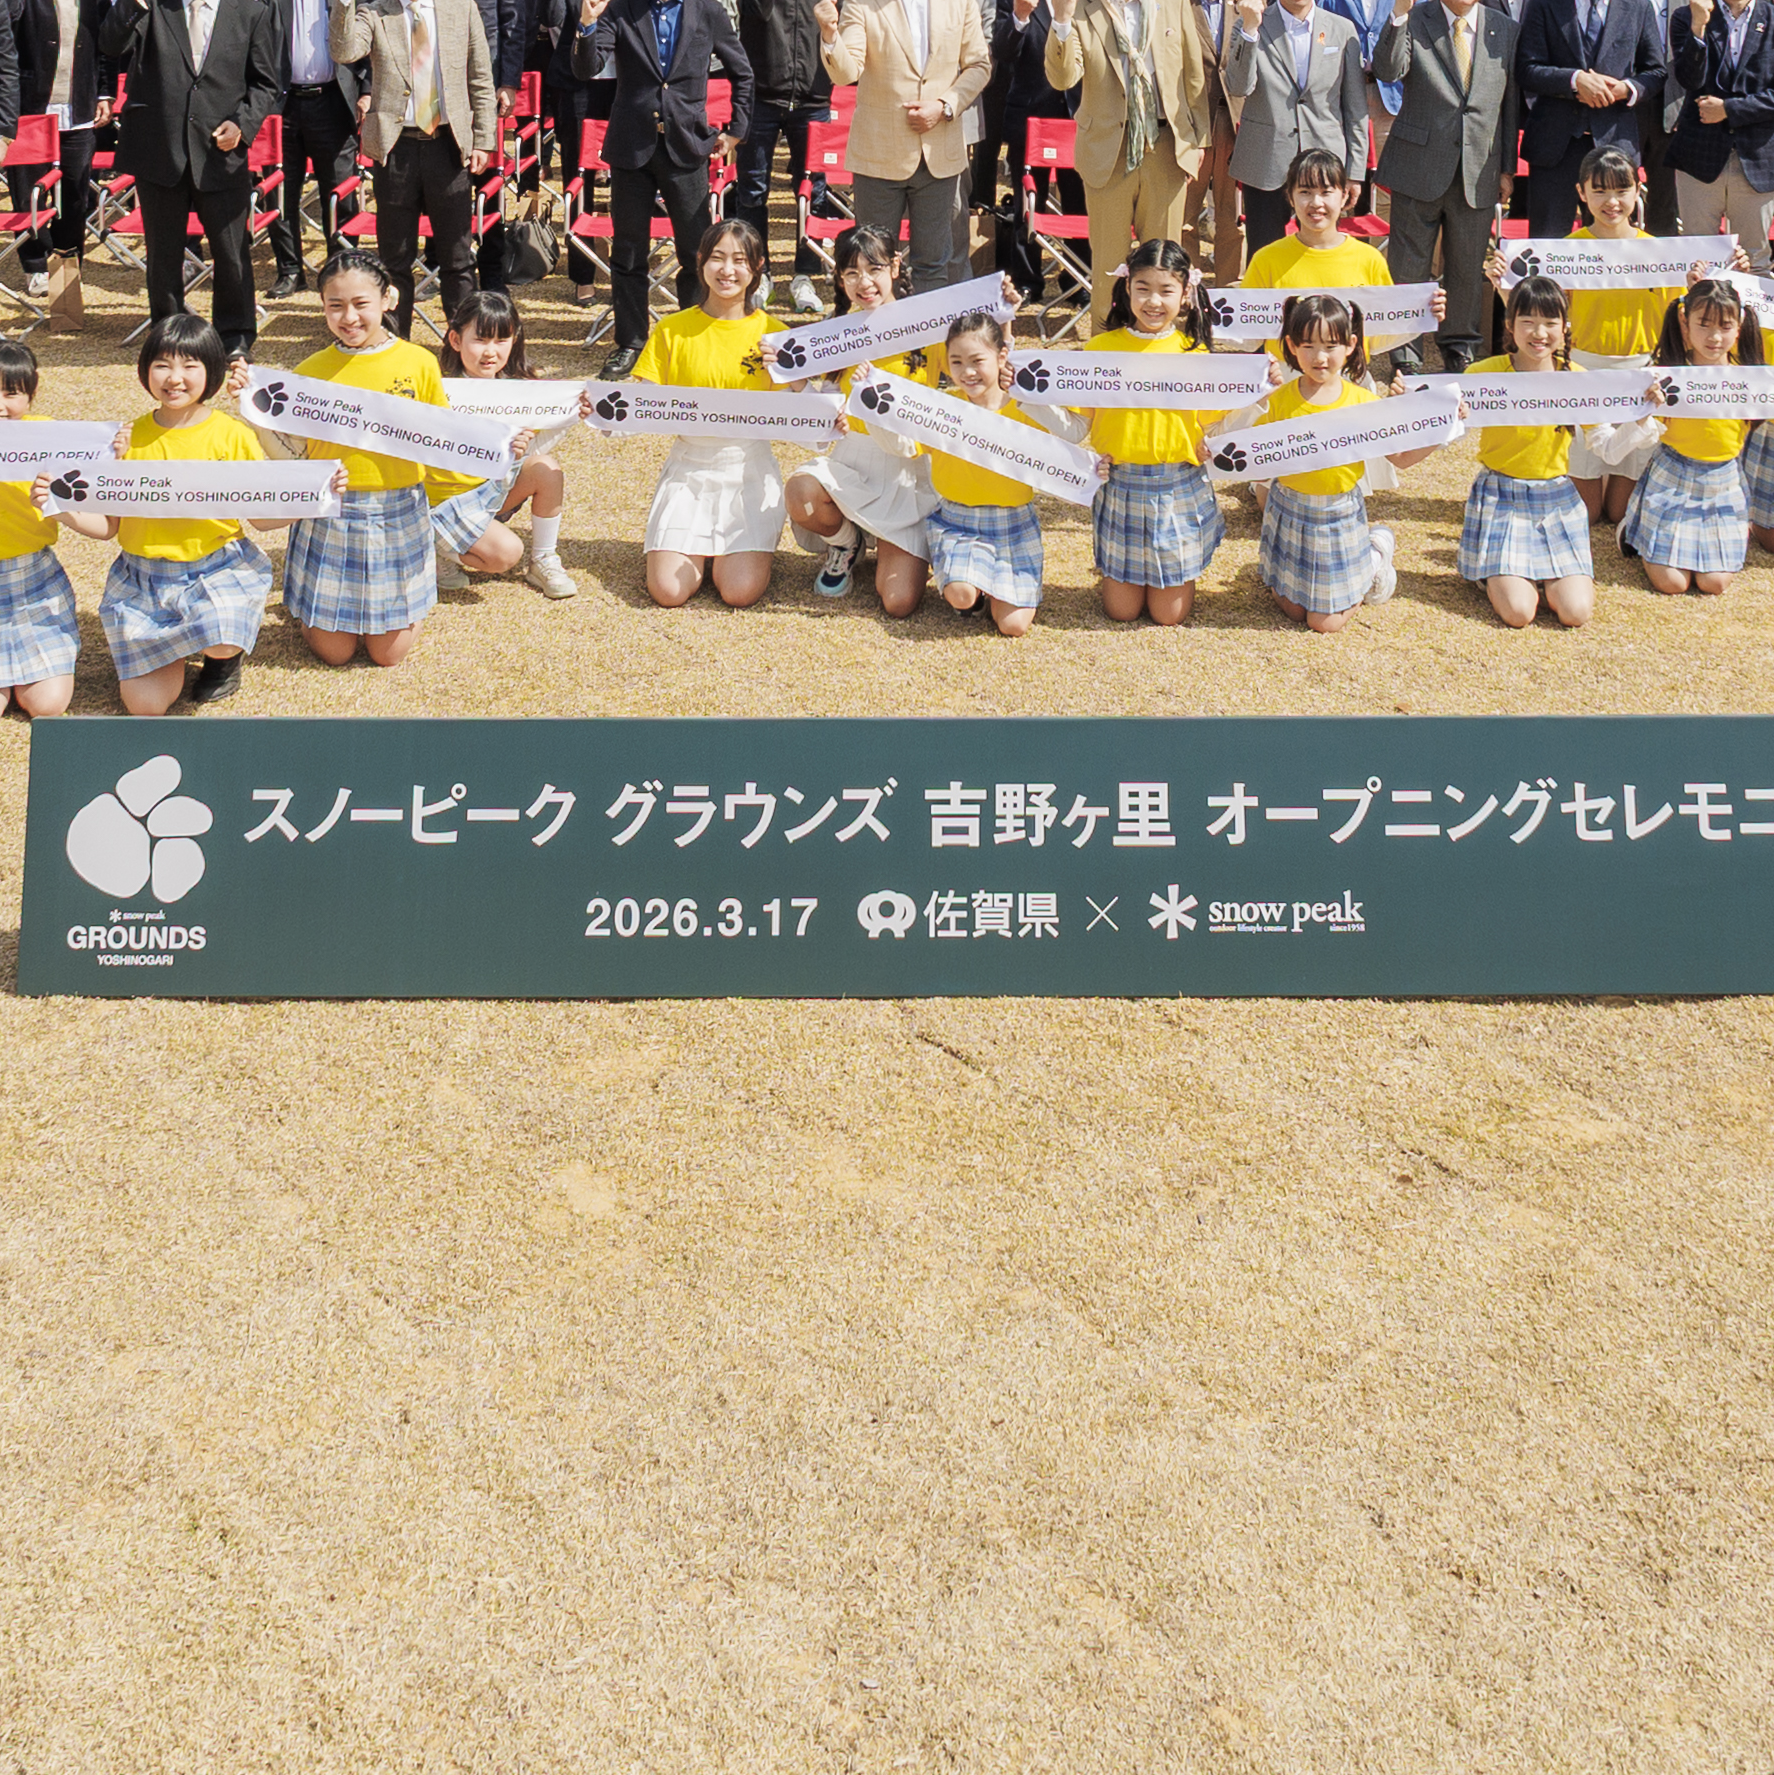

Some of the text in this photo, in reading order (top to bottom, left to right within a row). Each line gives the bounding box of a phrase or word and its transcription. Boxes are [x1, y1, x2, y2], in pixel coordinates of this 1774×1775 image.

[1546, 253, 1604, 263] Snow Peak
[1546, 264, 1604, 276] GROUNDS
[1606, 262, 1687, 275] YOSHINOGARI
[1745, 288, 1772, 302] Snow
[1239, 302, 1271, 314] Snow
[1240, 314, 1283, 326] GROUN
[1388, 307, 1426, 322] OPEN!
[809, 324, 872, 347] Snow Peak
[812, 336, 872, 360] GROUNDS
[875, 316, 957, 344] YOSHINOGARI
[1056, 365, 1122, 378] Snow Peak
[1056, 378, 1261, 395] GROUNDS YOSHINOGARI OPEN!
[1480, 386, 1507, 397] Peak
[1686, 381, 1748, 391] Snow Peak
[295, 392, 364, 415] Snow Peak
[635, 397, 699, 410] Snow Peak
[1465, 396, 1644, 411] OUNDS YOSHINOGARI OPEN!
[1686, 393, 1747, 405] GROUNDS
[535, 406, 573, 417] OPEN!
[900, 394, 963, 426] Snow Peak
[634, 410, 833, 429] GROUNDS YOSHINOGARI OPEN!
[292, 405, 501, 463] GROUNDS YOSHINOGARI OPEN!
[1253, 413, 1453, 466] GROUNDS YOSHINOGARI OPEN!
[896, 407, 1088, 488] GROUNDS YOSHINOGARI OPEN!
[1251, 430, 1316, 455] Snow Peak
[97, 475, 173, 488] Snow Peak
[96, 491, 170, 502] GROUNDS
[175, 491, 276, 503] YOSHINOGARI
[243, 783, 577, 847] スノーピーク
[605, 777, 899, 848] グラウンズ
[925, 782, 1176, 847] 吉野ヶ里
[585, 889, 1365, 938] 2026.3.17 佐賀県 snow peak
[66, 925, 206, 950] GROUNDS
[97, 954, 174, 966] YOSHINOGARI
